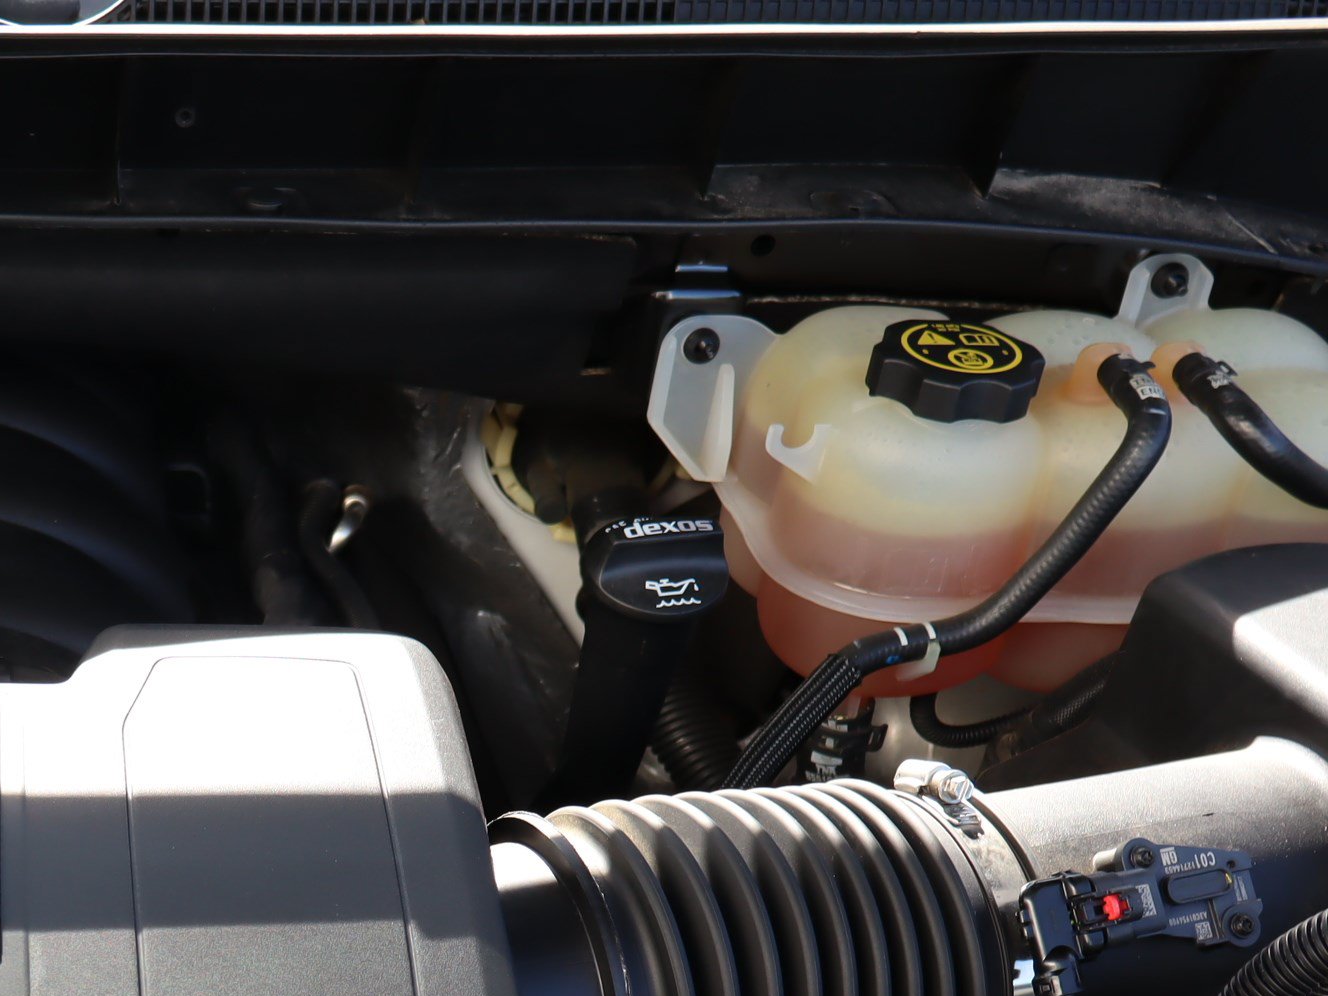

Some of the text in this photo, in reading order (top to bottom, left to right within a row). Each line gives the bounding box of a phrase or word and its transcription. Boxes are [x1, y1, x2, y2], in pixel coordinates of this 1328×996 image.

[623, 520, 714, 539] dexos
[1160, 850, 1178, 866] GM
[1194, 851, 1216, 869] C01
